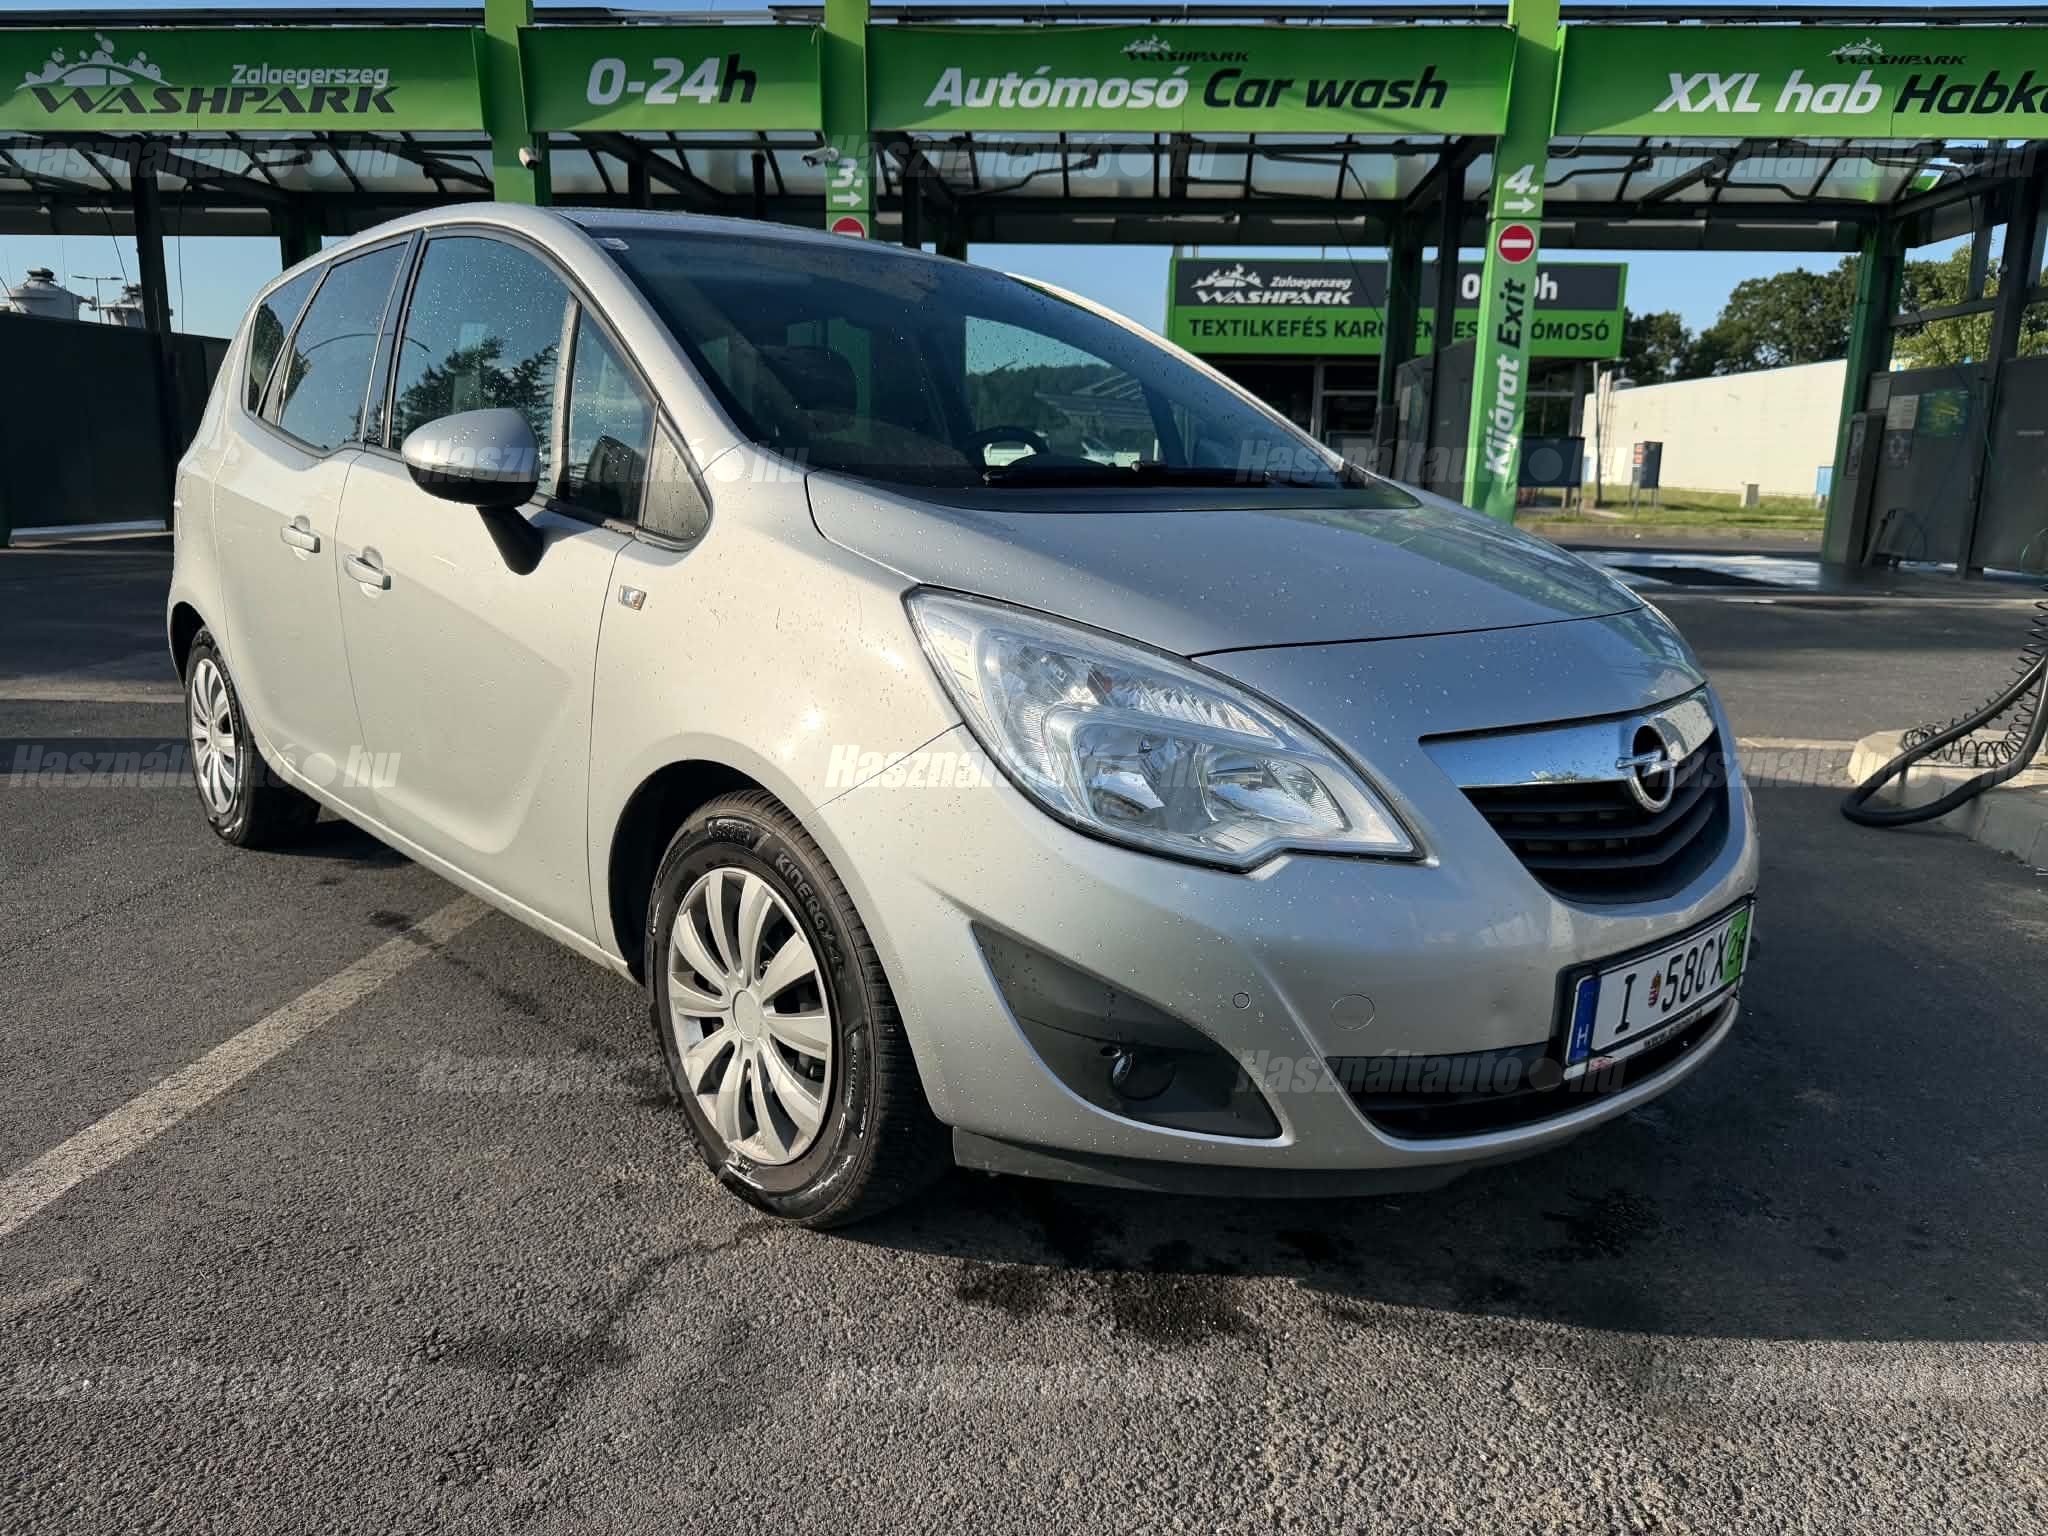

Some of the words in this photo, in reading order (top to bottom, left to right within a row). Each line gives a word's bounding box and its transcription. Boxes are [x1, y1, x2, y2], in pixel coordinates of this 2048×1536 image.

[1126, 50, 1249, 63] WASHPARK
[1832, 54, 1969, 65] WASHPARK
[231, 63, 390, 90] Zalaegerszeg
[586, 53, 758, 105] 0-24h
[923, 66, 1191, 109] Autómosó
[1203, 67, 1297, 108] Car
[1304, 64, 1449, 109] wash
[1652, 72, 1761, 113] XXL
[1773, 69, 1883, 114] hab
[31, 86, 401, 114] WASHPARK
[831, 158, 864, 188] 3.
[1503, 164, 1540, 194] 4.
[1195, 289, 1353, 305] WASHPARK
[1269, 275, 1353, 290] Zalaegerszeg
[1188, 315, 1328, 338] TEXTILKEFÉS
[1497, 278, 1526, 350] Exit
[1484, 354, 1520, 479] Kijárat
[1614, 972, 1637, 1036] I
